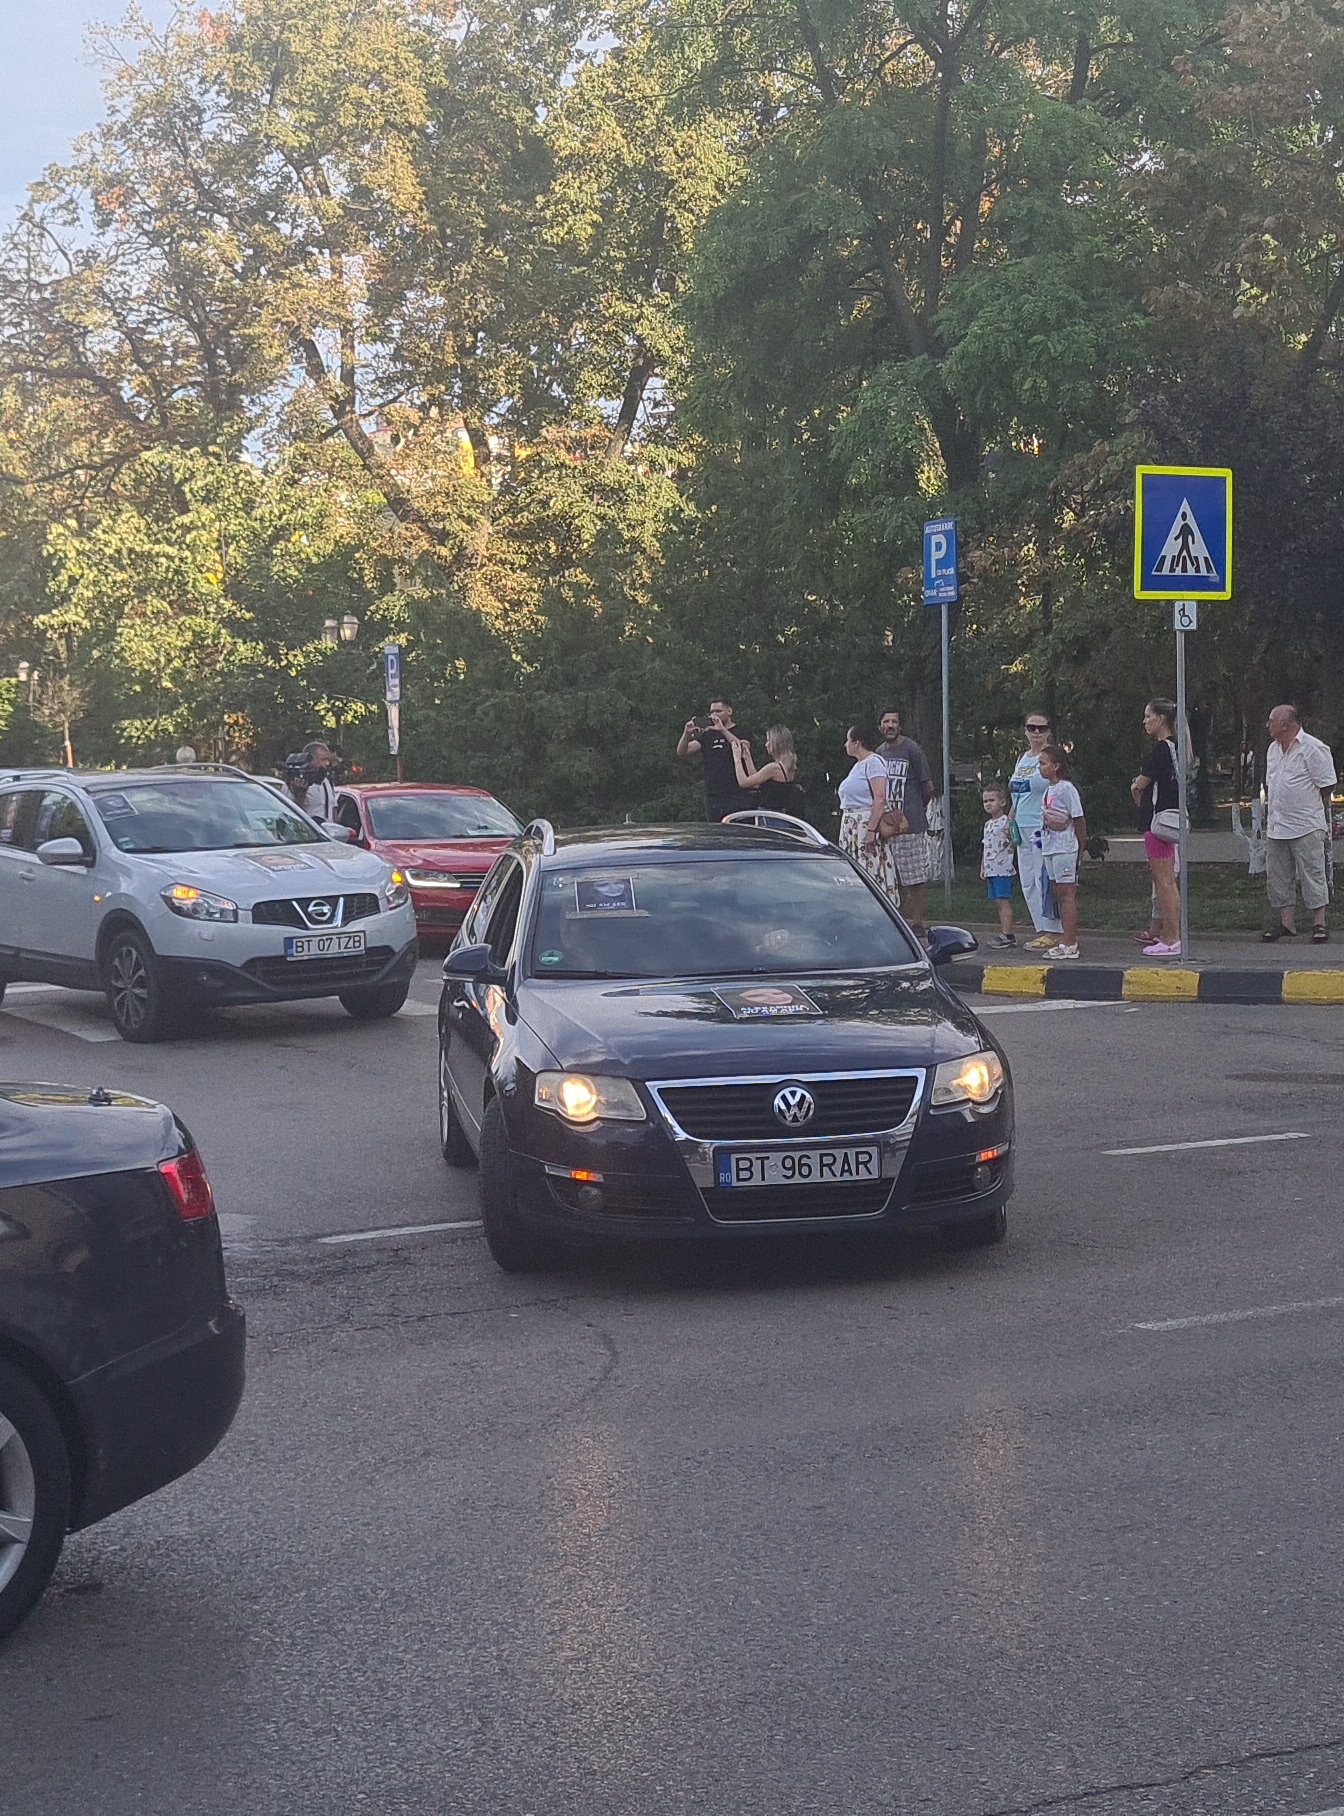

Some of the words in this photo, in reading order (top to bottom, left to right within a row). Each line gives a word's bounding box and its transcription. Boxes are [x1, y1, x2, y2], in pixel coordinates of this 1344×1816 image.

[931, 534, 947, 579] P
[295, 940, 312, 954] BT
[317, 937, 333, 952] 07
[336, 934, 362, 951] TZB
[719, 1172, 731, 1183] RO
[735, 1155, 770, 1183] BT
[781, 1154, 813, 1180] 96
[819, 1150, 873, 1179] RAR
